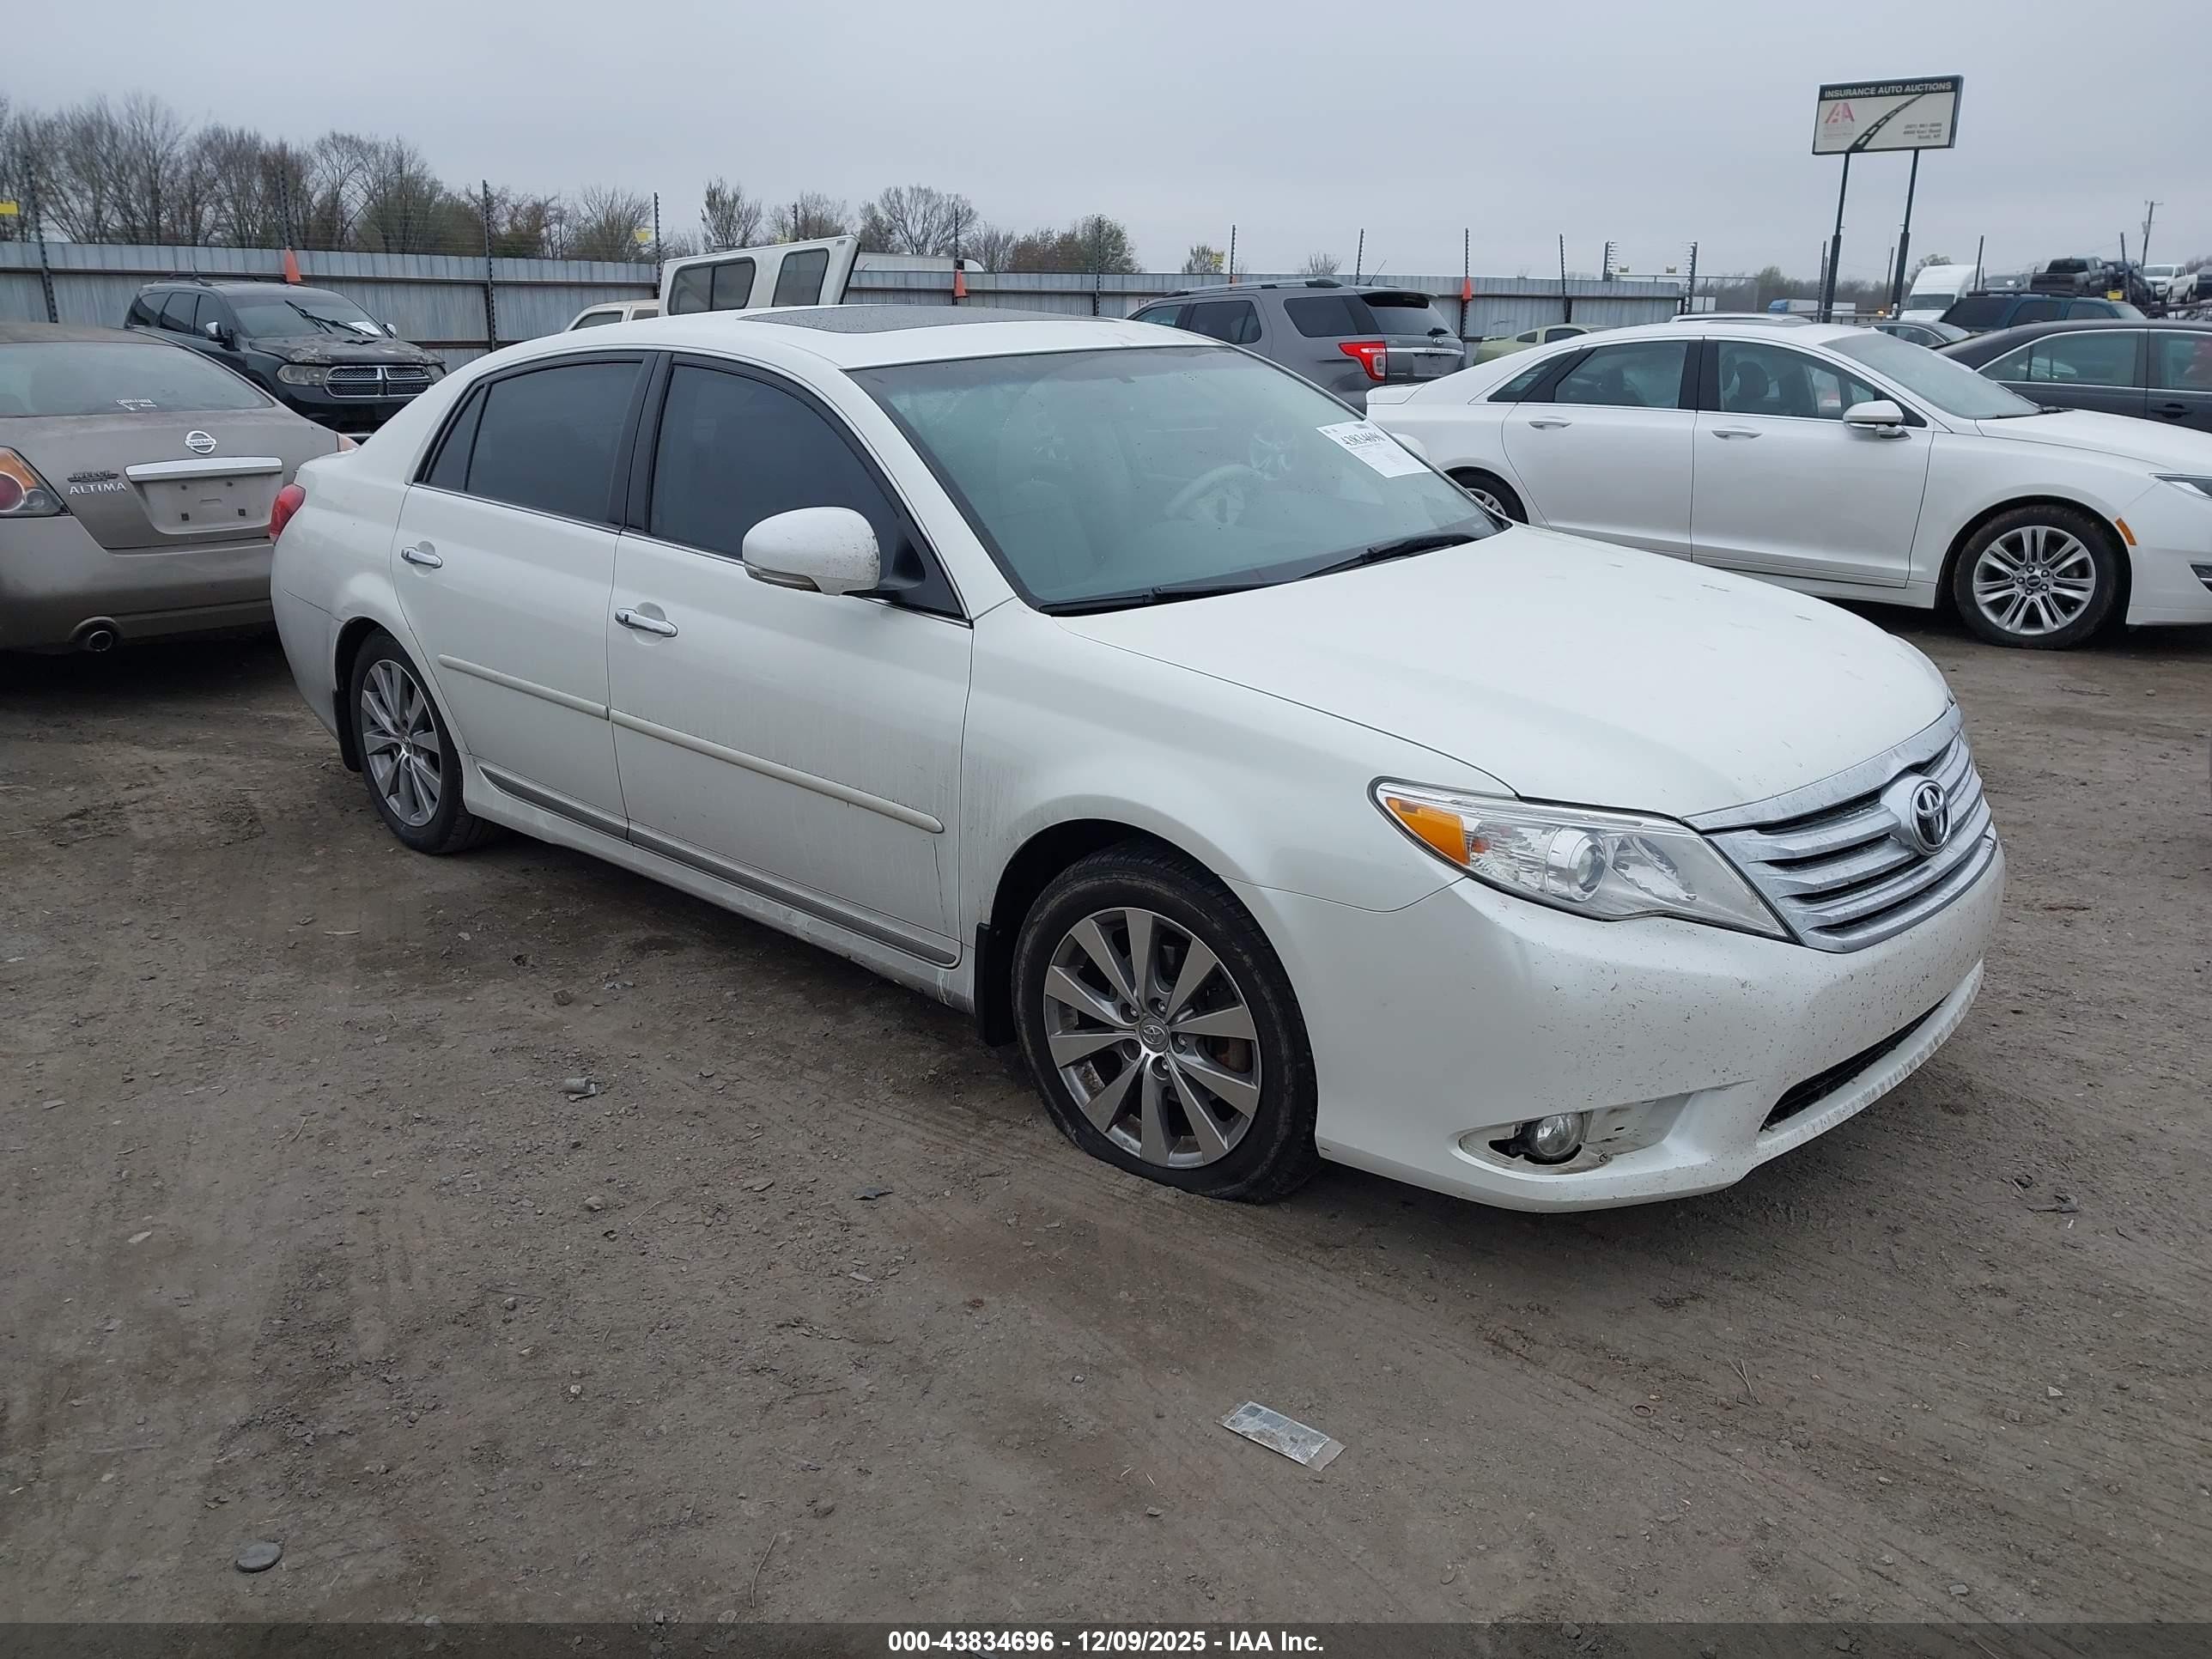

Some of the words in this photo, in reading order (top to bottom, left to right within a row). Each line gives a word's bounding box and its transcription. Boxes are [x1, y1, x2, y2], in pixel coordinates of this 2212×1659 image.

[1824, 87, 1876, 98] INSURANCE
[1877, 84, 1903, 94] AUTO
[1904, 82, 1952, 93] AUCTIONS
[69, 483, 127, 495] ALTIMA
